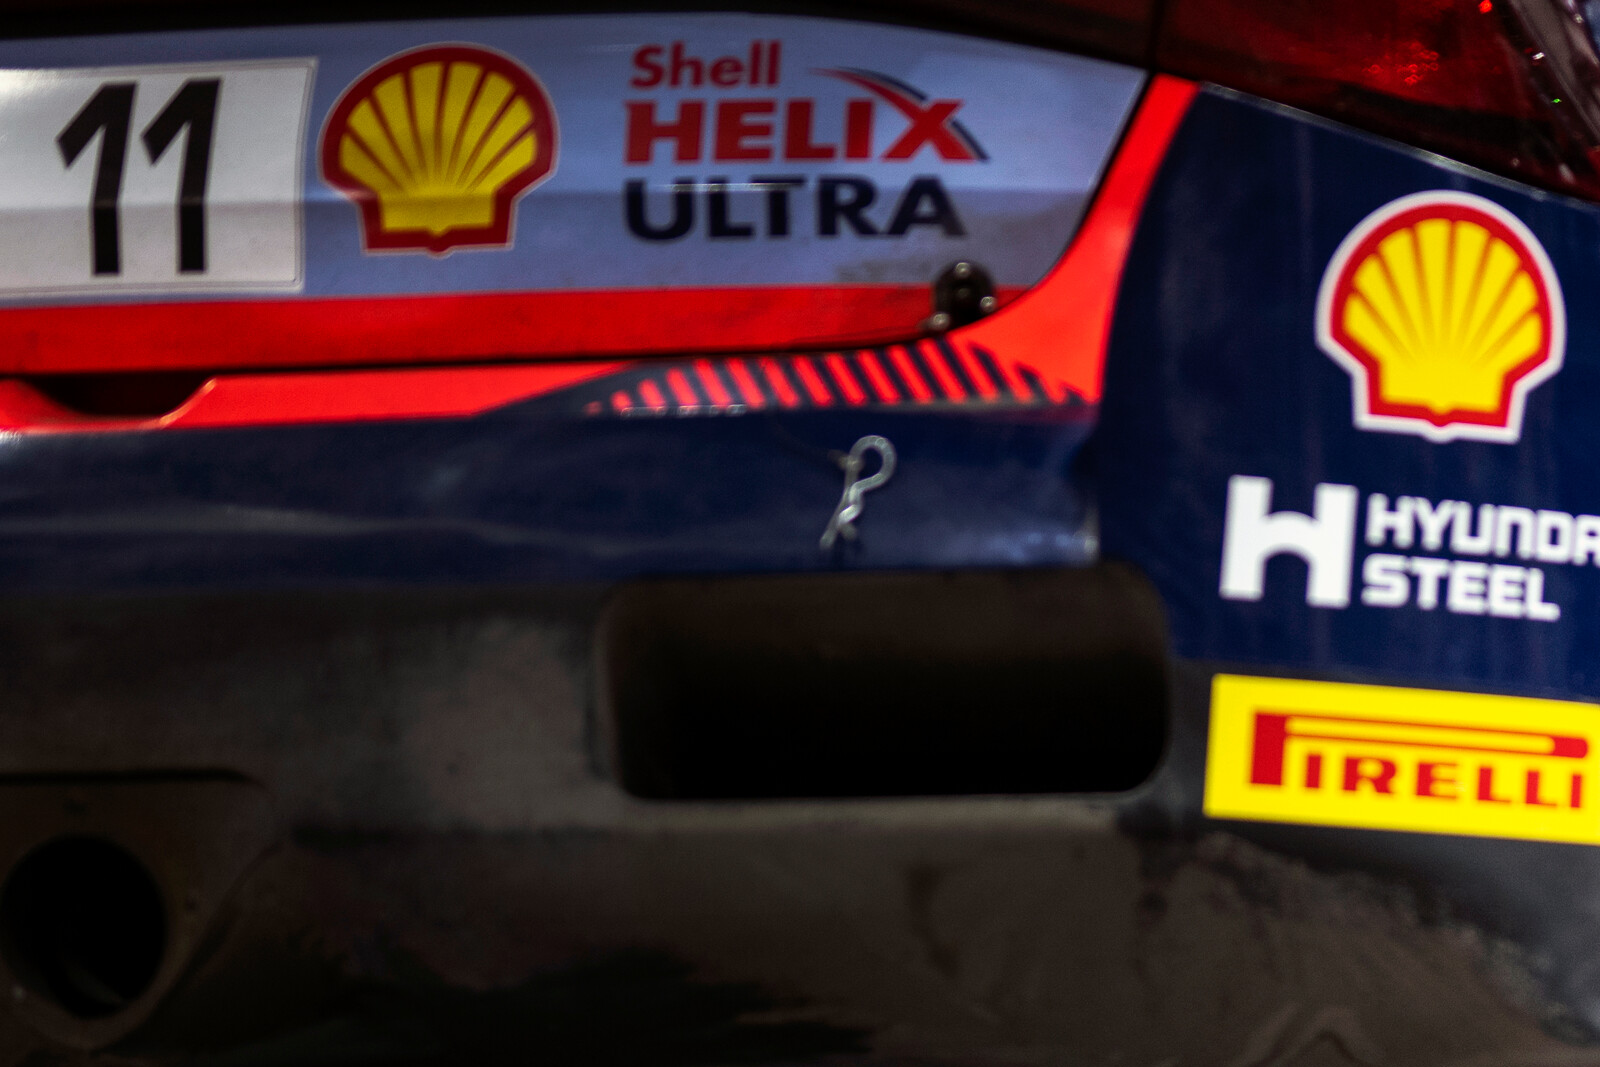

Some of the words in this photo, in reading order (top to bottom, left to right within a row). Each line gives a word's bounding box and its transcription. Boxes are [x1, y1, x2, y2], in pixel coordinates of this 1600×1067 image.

[629, 39, 782, 89] Shell
[623, 69, 988, 165] HELIX
[56, 77, 222, 277] 11
[623, 174, 966, 241] ULTRA
[1360, 553, 1561, 622] STEEL
[1248, 710, 1590, 810] PIRELLI
